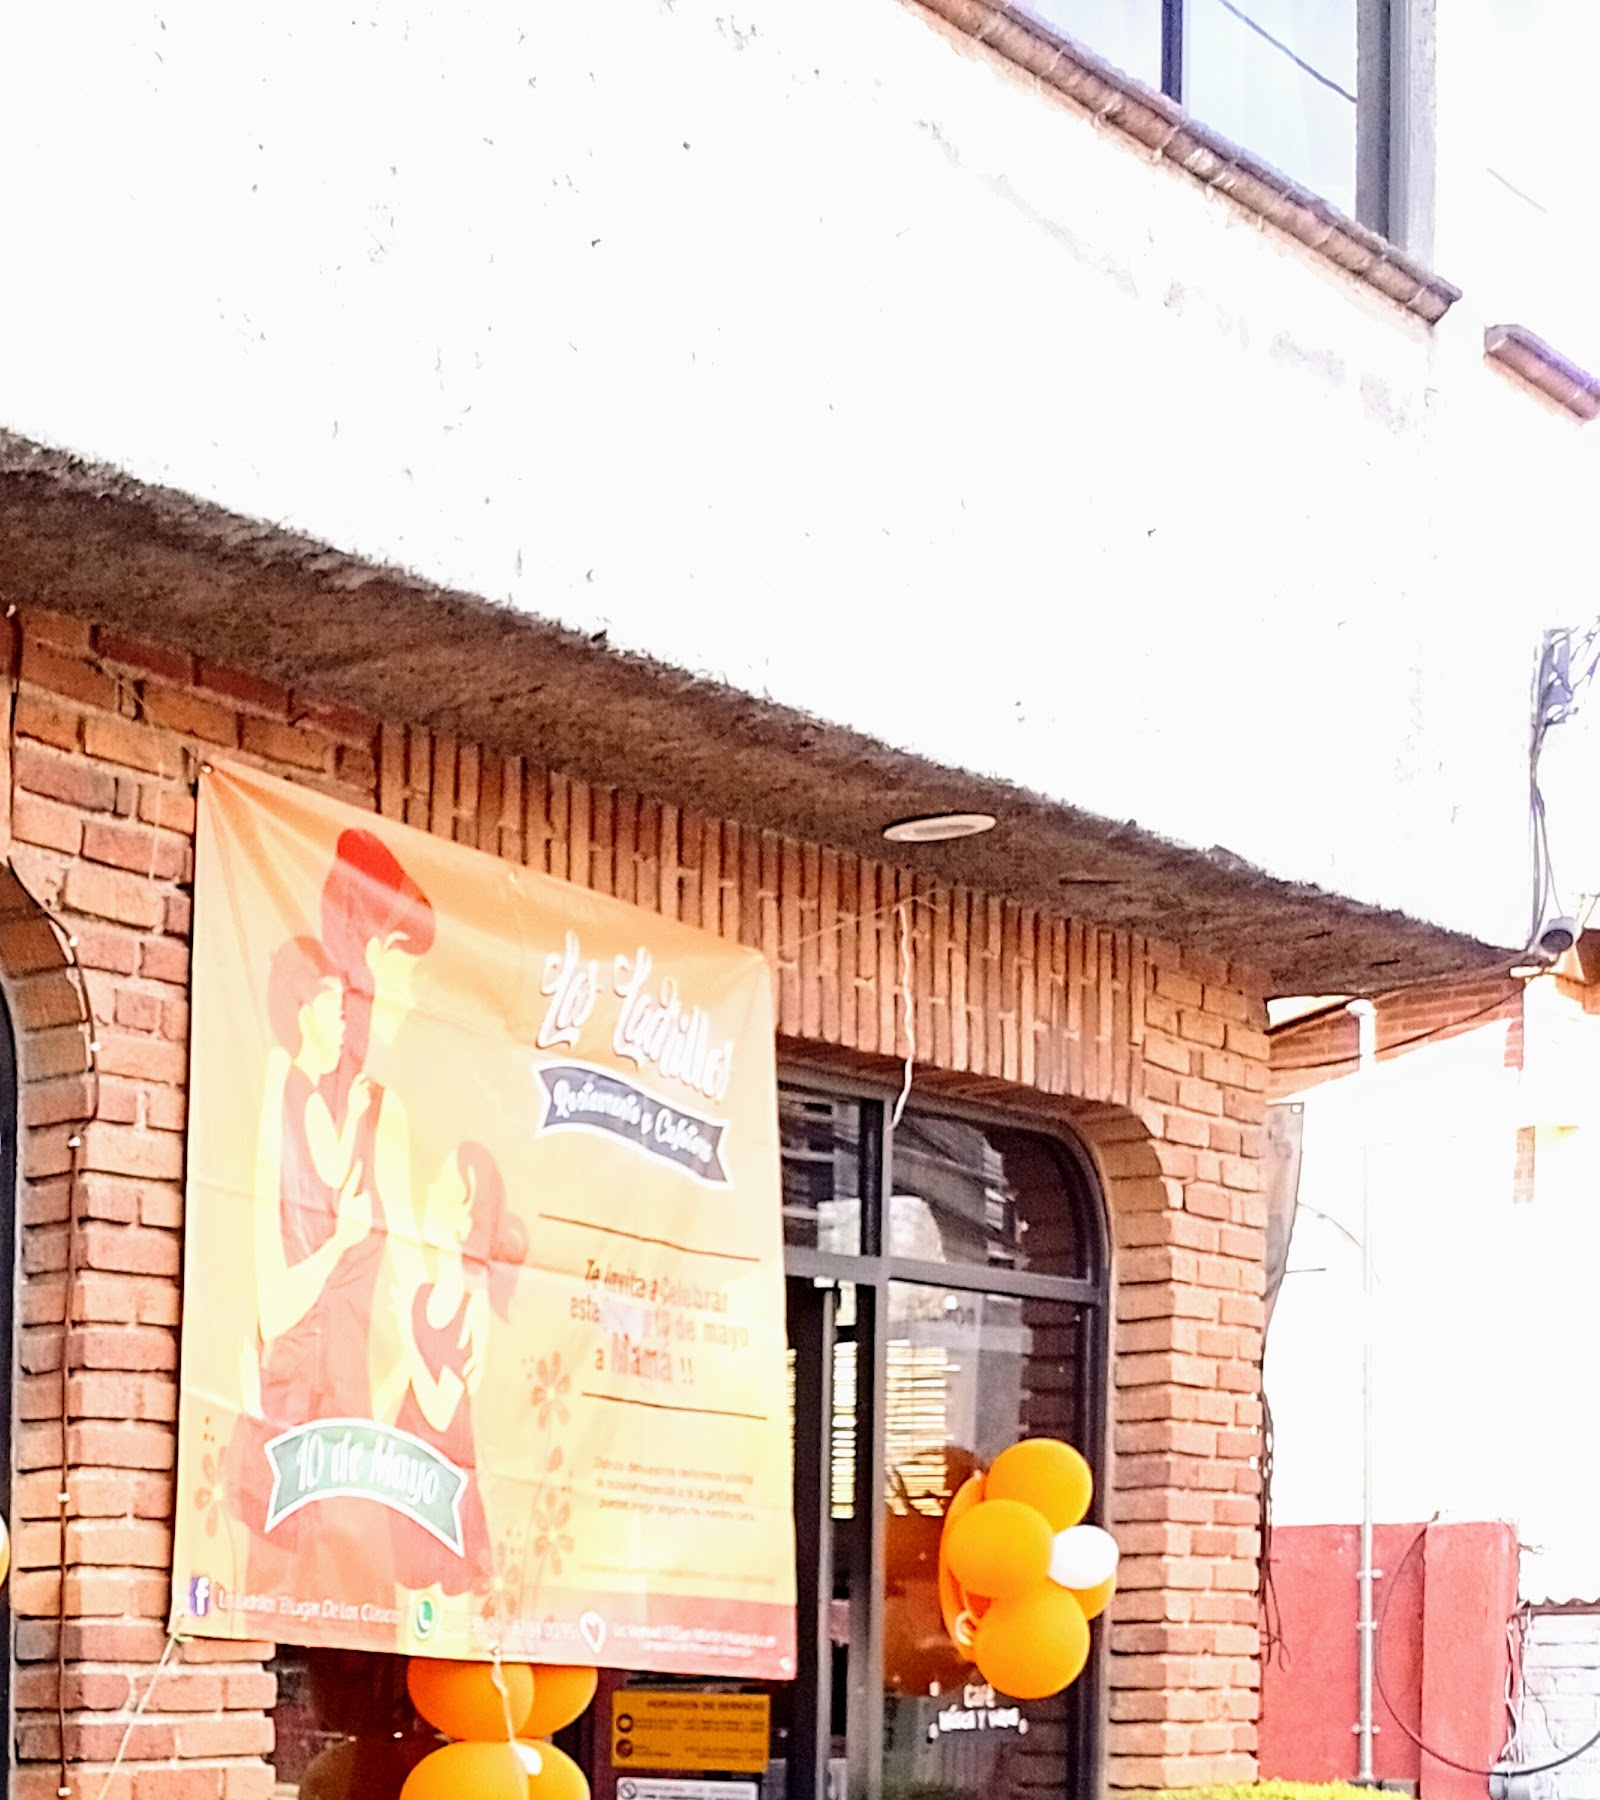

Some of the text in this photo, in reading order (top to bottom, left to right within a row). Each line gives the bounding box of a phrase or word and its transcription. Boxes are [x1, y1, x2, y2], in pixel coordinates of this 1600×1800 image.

[535, 929, 604, 1050] Los
[296, 1430, 441, 1506] 10 de Mayo
